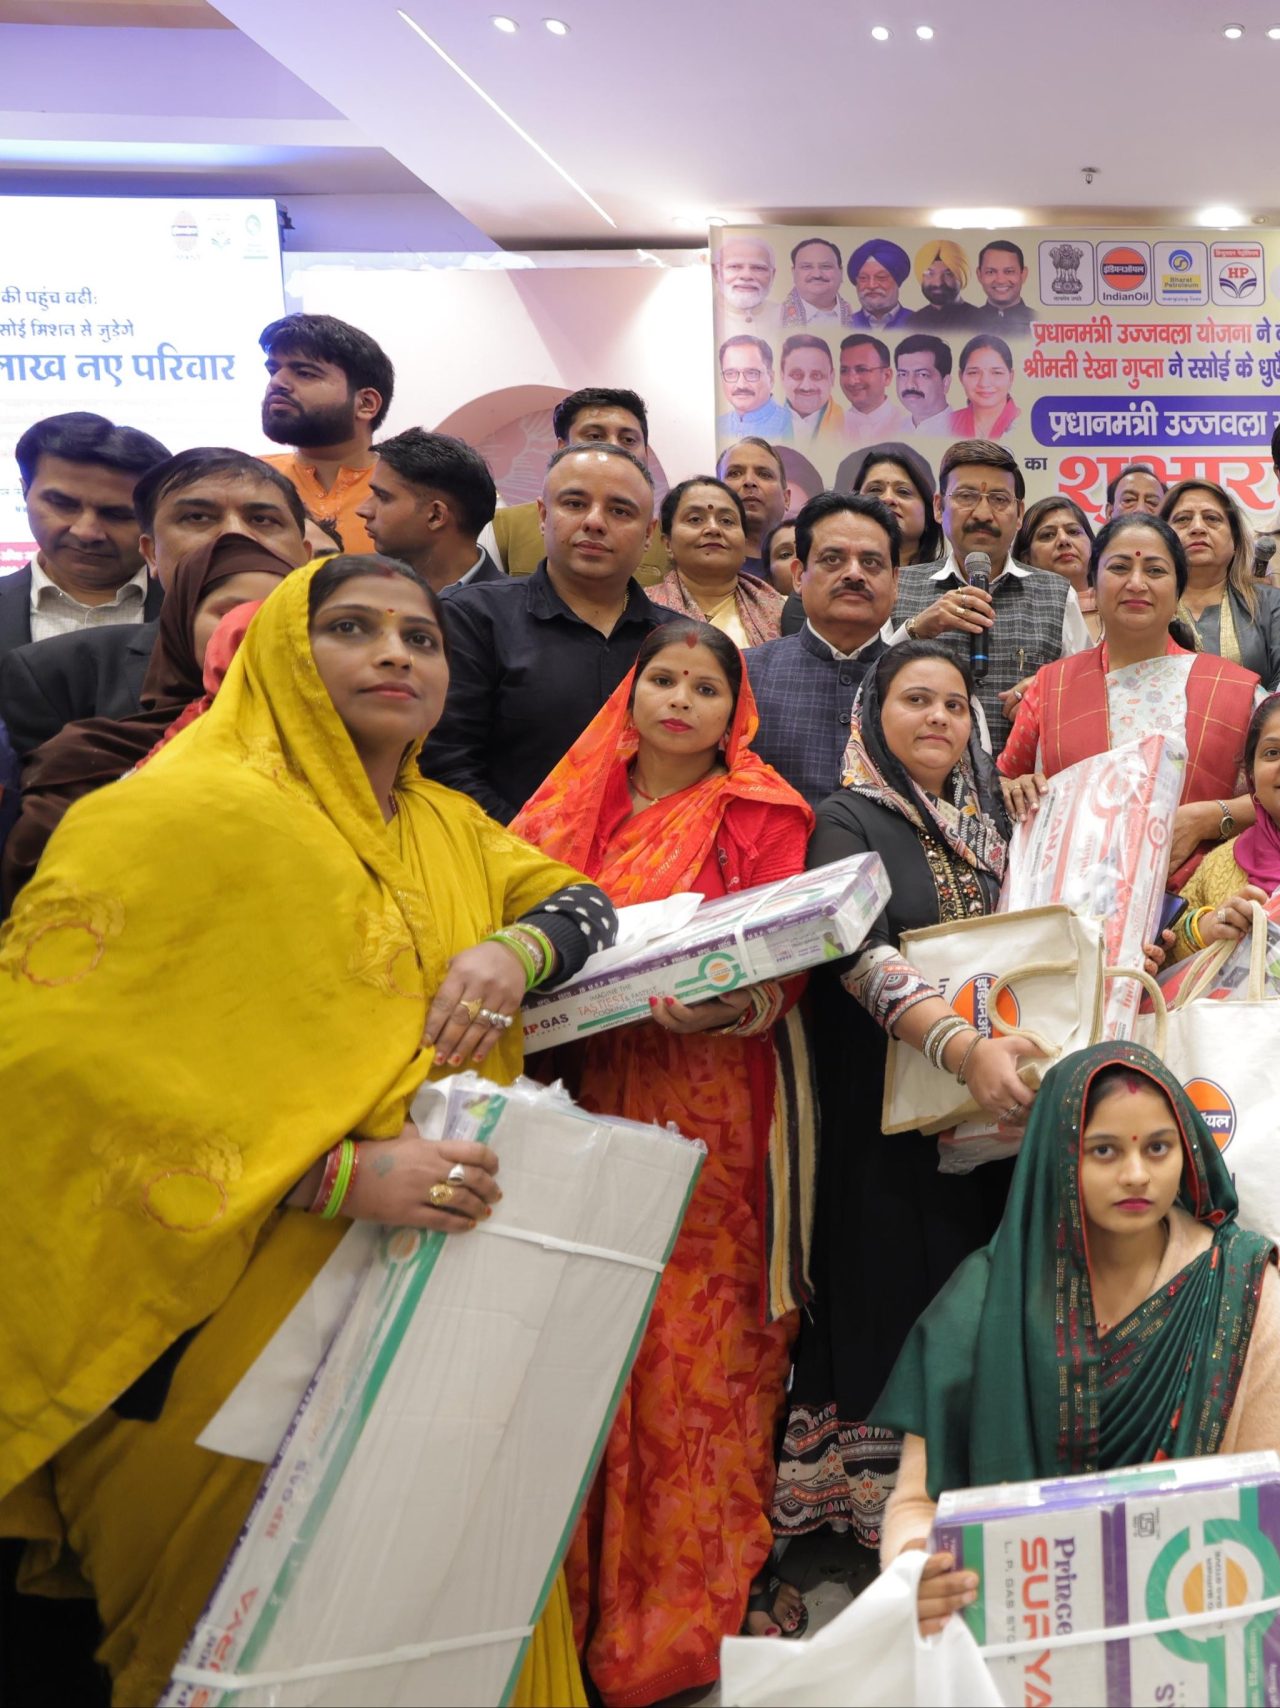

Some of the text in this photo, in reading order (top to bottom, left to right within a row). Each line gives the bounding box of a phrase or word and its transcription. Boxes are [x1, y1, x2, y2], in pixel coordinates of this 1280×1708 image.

[1228, 267, 1249, 279] HP
[1103, 292, 1149, 301] IndianOil
[1033, 315, 1112, 346] प्रधानमंत्री
[1117, 324, 1192, 344] उज्जवला
[1196, 317, 1252, 344] योजना
[1256, 317, 1271, 343] ने
[76, 354, 123, 388] नए
[133, 342, 235, 381] परिवार
[1024, 350, 1078, 378] श्रीमती
[1083, 351, 1117, 379] रेखा
[1121, 358, 1164, 390] गुप्ता
[1168, 351, 1183, 378] ने
[1188, 350, 1231, 381] रसोई
[1235, 351, 1253, 378] के
[1049, 401, 1158, 441] प्रधानमंत्री
[1164, 411, 1268, 437] उज्जवला
[1025, 457, 1047, 471] का
[577, 994, 626, 1016] TASTIEST
[541, 1013, 569, 1030] GAS
[1004, 1578, 1015, 1609] GAS
[1054, 1536, 1076, 1636] Prince
